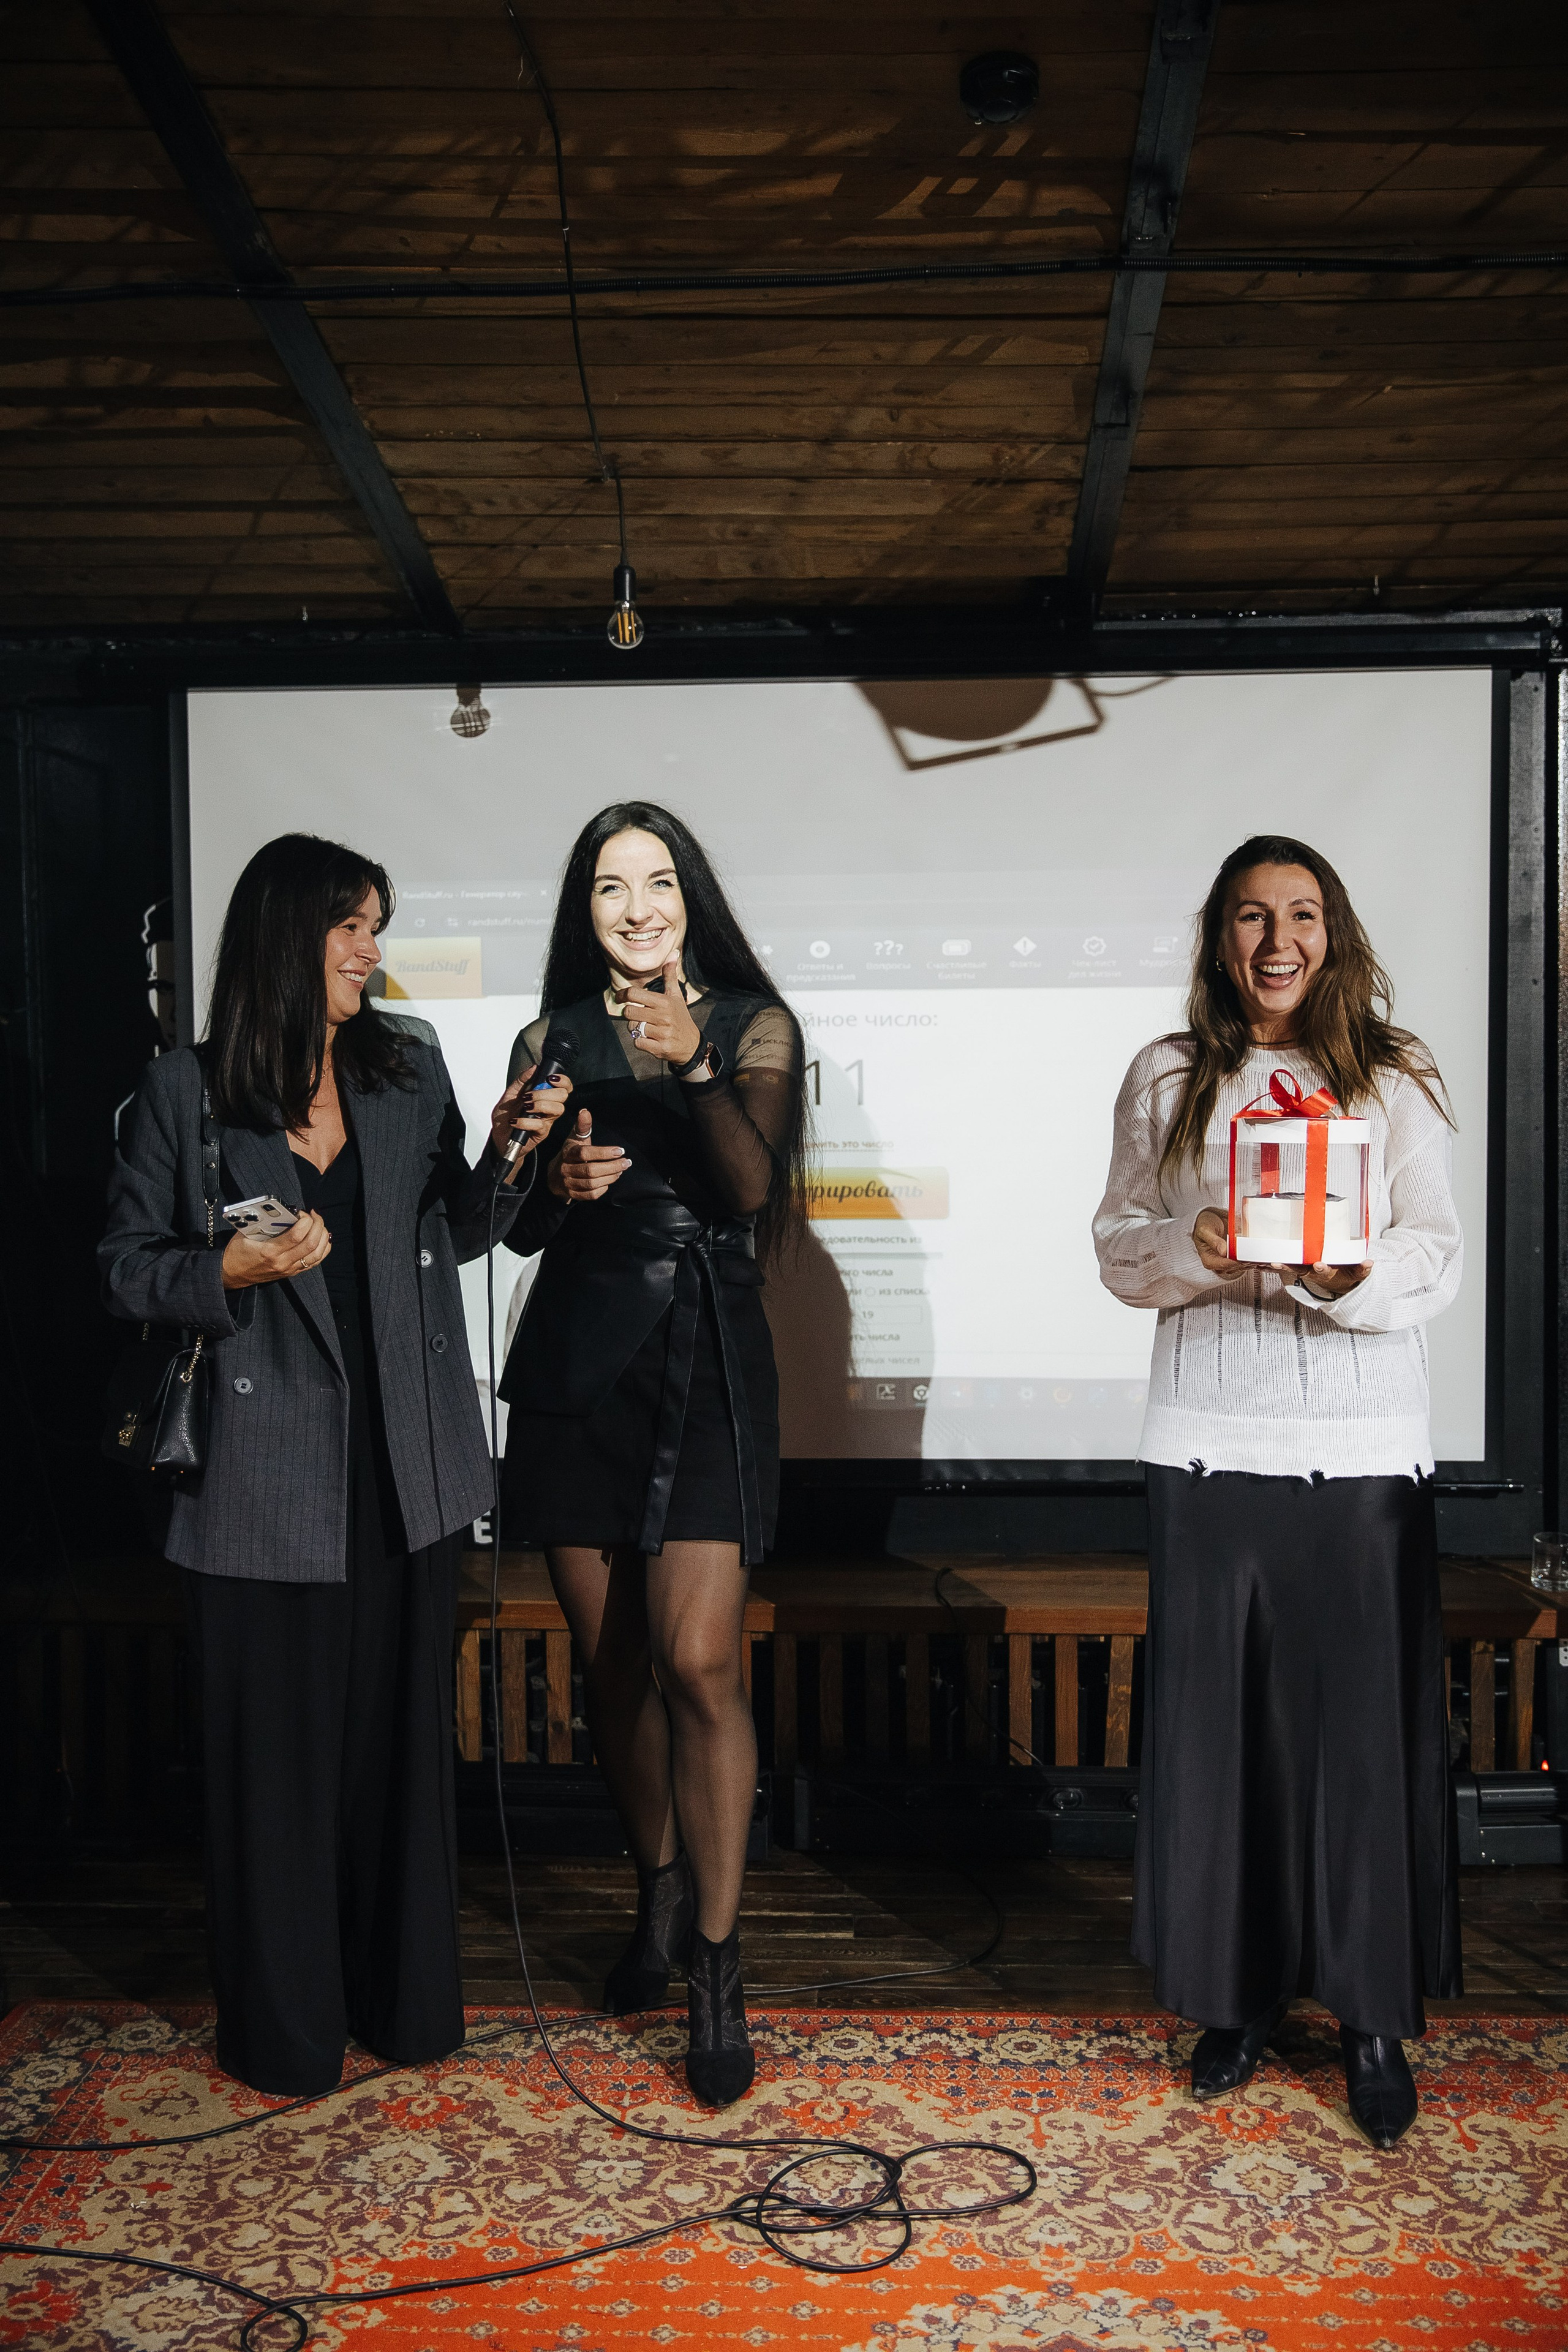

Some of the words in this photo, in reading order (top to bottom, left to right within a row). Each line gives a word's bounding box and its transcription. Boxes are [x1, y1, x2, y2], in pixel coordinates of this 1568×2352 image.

[395, 959, 471, 975] RandStuff
[866, 962, 911, 971] Вопросы
[1008, 960, 1042, 969] Факты
[804, 1012, 858, 1027] йное
[865, 1014, 938, 1027] число:
[842, 1140, 860, 1149] это
[861, 1140, 894, 1149] число
[812, 1180, 924, 1204] рировать
[823, 1236, 908, 1245] довательность
[861, 1268, 894, 1277] числа
